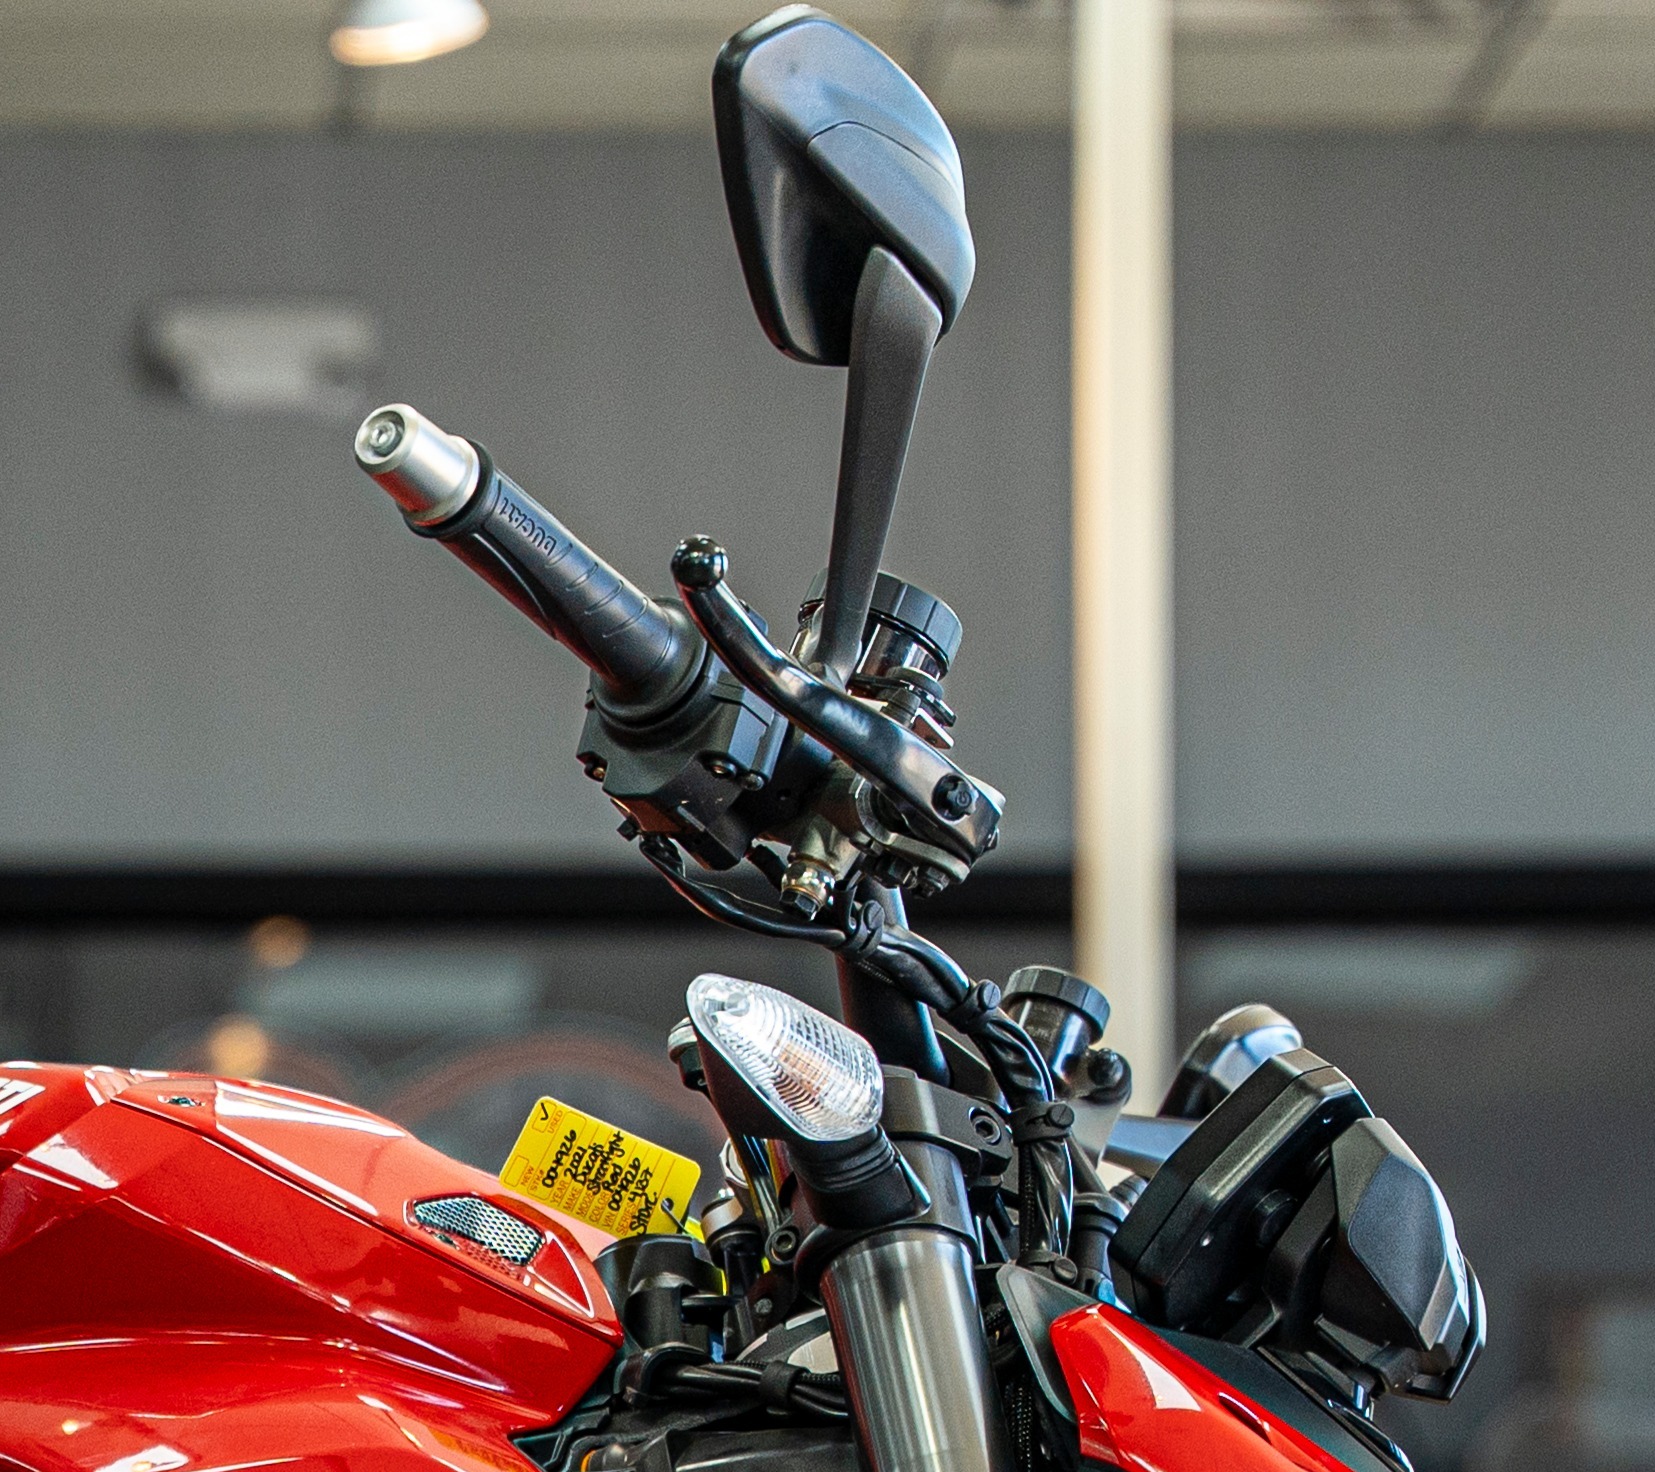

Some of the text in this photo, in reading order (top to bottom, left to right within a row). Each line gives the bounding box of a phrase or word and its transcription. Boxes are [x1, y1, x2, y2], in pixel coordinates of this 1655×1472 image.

[499, 497, 557, 556] DUCATI
[548, 1110, 564, 1134] USED
[520, 1165, 535, 1187] NEW
[551, 1146, 587, 1204] YEAR 2021
[589, 1163, 624, 1223] COLOR Red
[563, 1186, 583, 1211] MAKE
